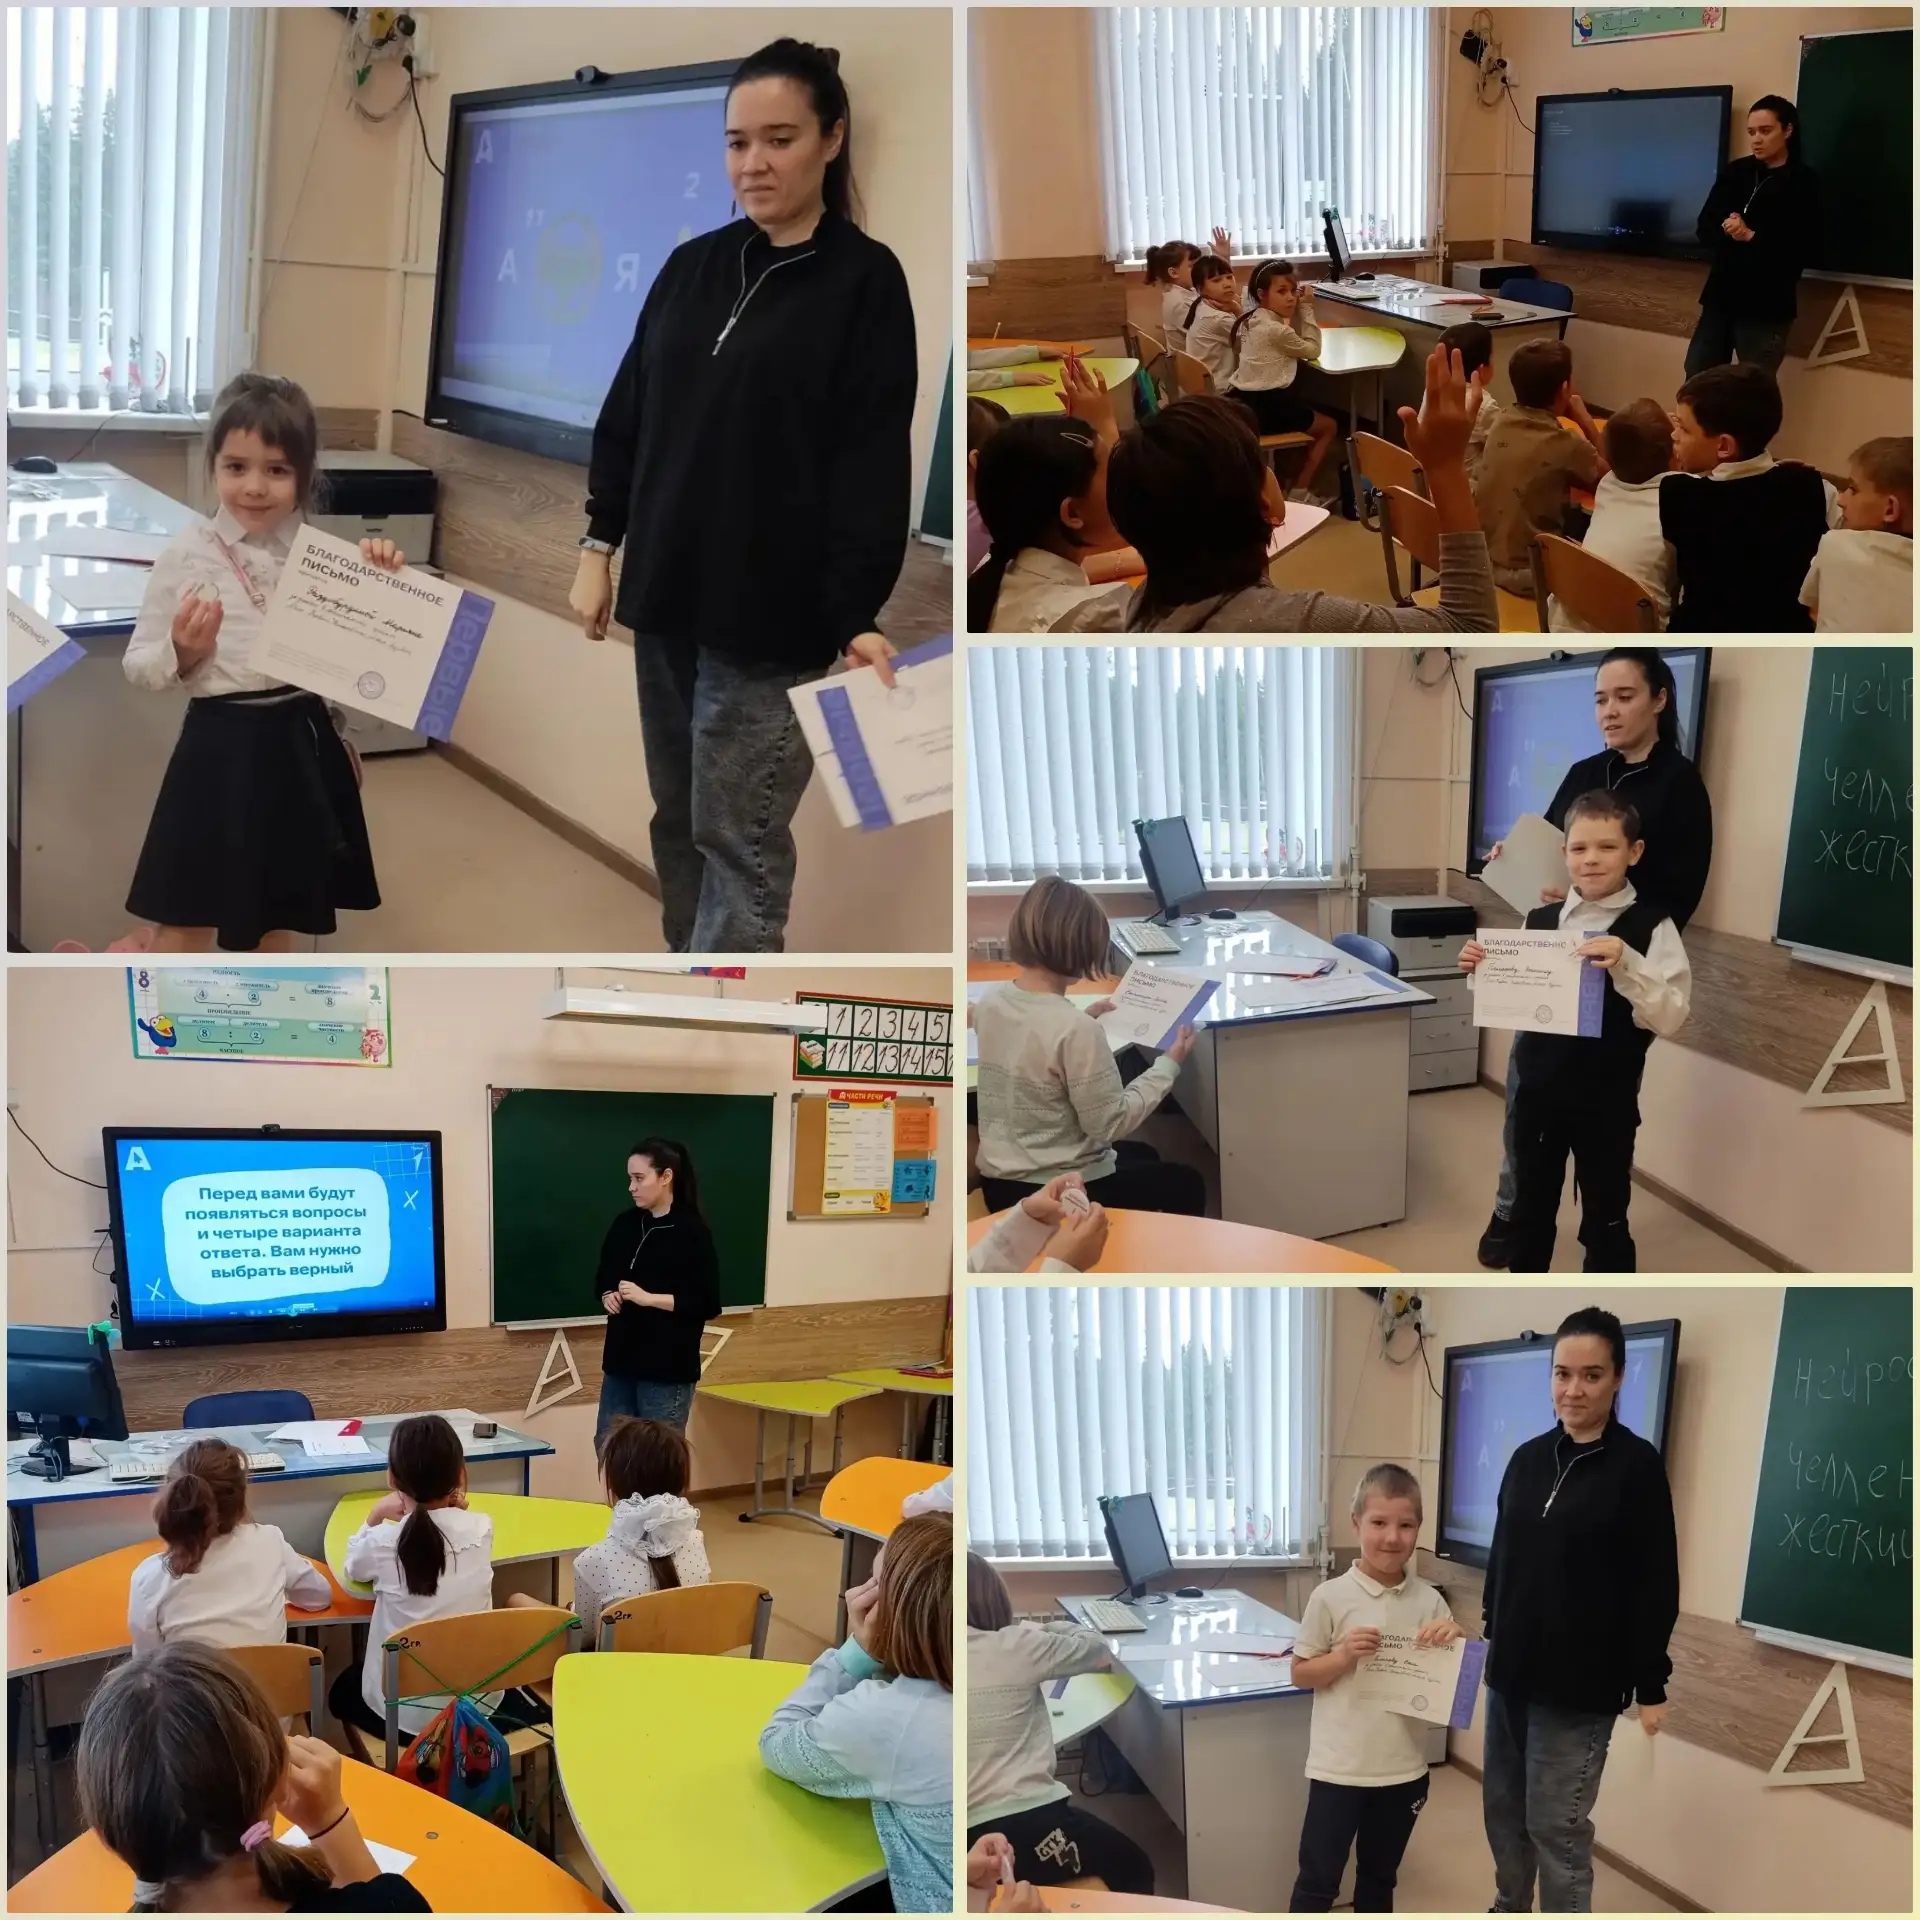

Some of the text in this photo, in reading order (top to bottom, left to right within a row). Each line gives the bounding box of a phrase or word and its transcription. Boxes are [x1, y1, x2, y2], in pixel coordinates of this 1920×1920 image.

[614, 253, 640, 292] Я
[301, 557, 360, 587] ПИСЬМО
[306, 544, 444, 606] БЛАГОДАРСТВЕННОЕ
[139, 970, 150, 988] 8
[369, 984, 381, 1000] 2
[836, 1007, 944, 1041] 1 2 3 4 5
[827, 1041, 849, 1069] 11
[852, 1043, 875, 1071] 12
[877, 1045, 899, 1072] 13
[900, 1046, 922, 1073] 14
[924, 1048, 946, 1075] 15
[846, 1092, 866, 1100] ЧАСТИ
[199, 1187, 355, 1202] Перед вами будут
[185, 1206, 367, 1221] появляться вопросы
[198, 1226, 361, 1242] и четыре варианта
[200, 1244, 361, 1259] ответа. Вам нужно
[211, 1262, 354, 1281] выбрать верный
